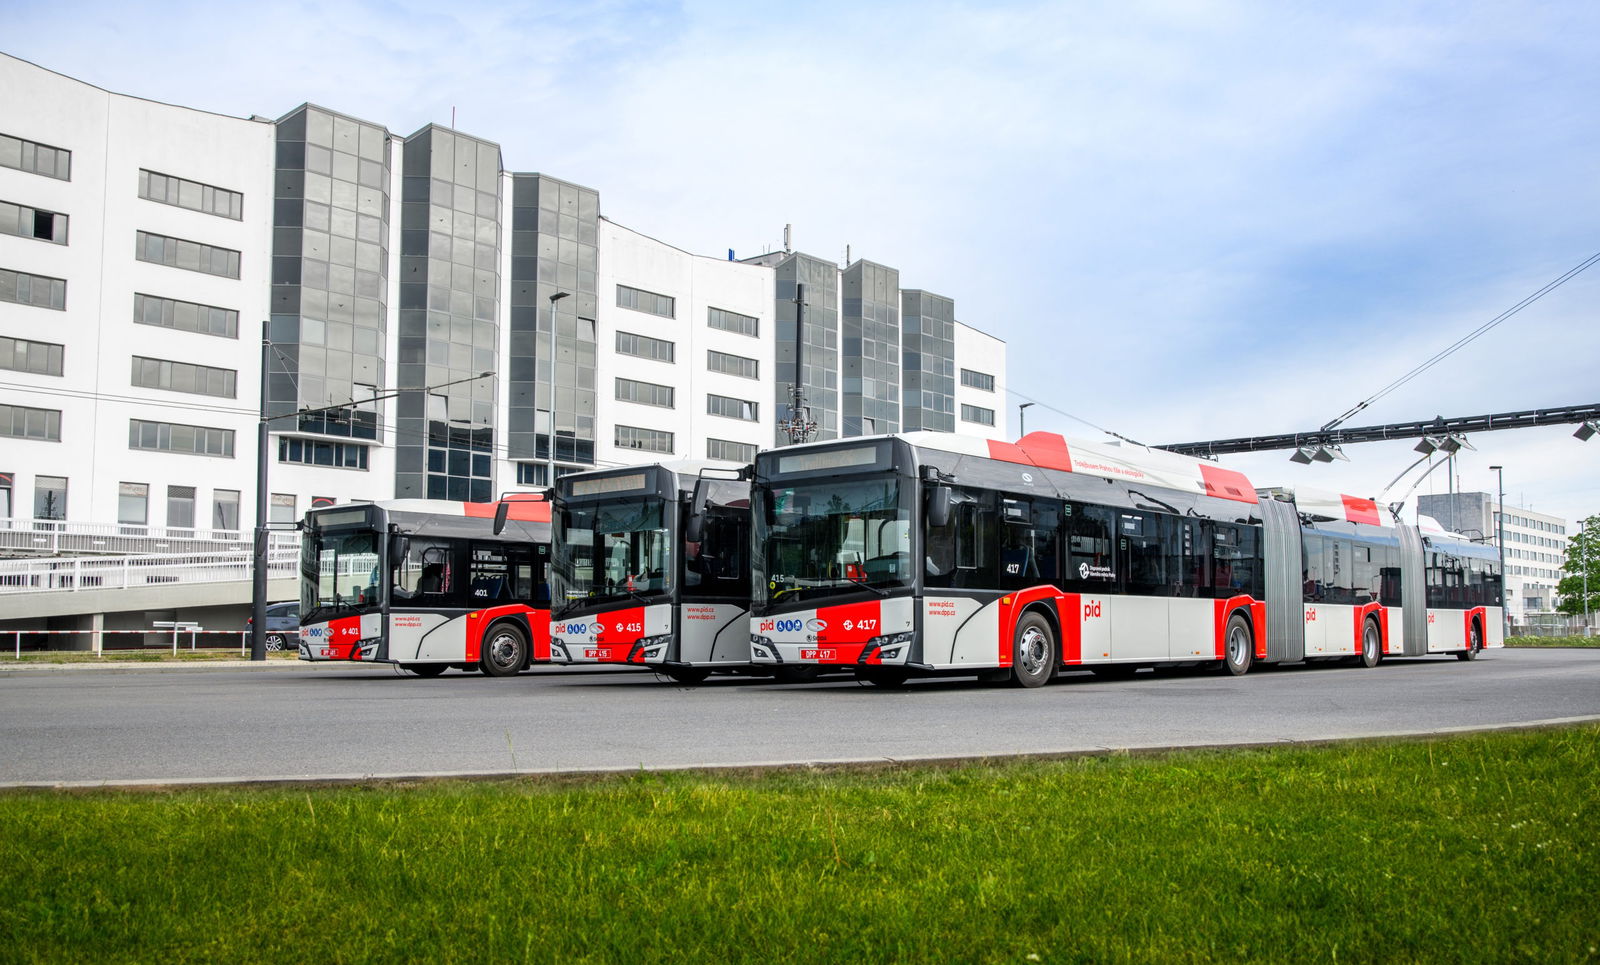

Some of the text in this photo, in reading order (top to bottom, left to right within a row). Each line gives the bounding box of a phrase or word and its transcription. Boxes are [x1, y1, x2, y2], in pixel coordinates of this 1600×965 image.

[1006, 563, 1019, 574] 417
[771, 574, 785, 583] 415
[1084, 600, 1101, 622] pid
[1306, 607, 1316, 624] pid
[556, 623, 566, 635] pid
[626, 622, 642, 632] 415
[760, 619, 774, 634] pid
[856, 619, 876, 630] 417
[348, 628, 359, 636] 401
[805, 650, 830, 659] DPP 417
